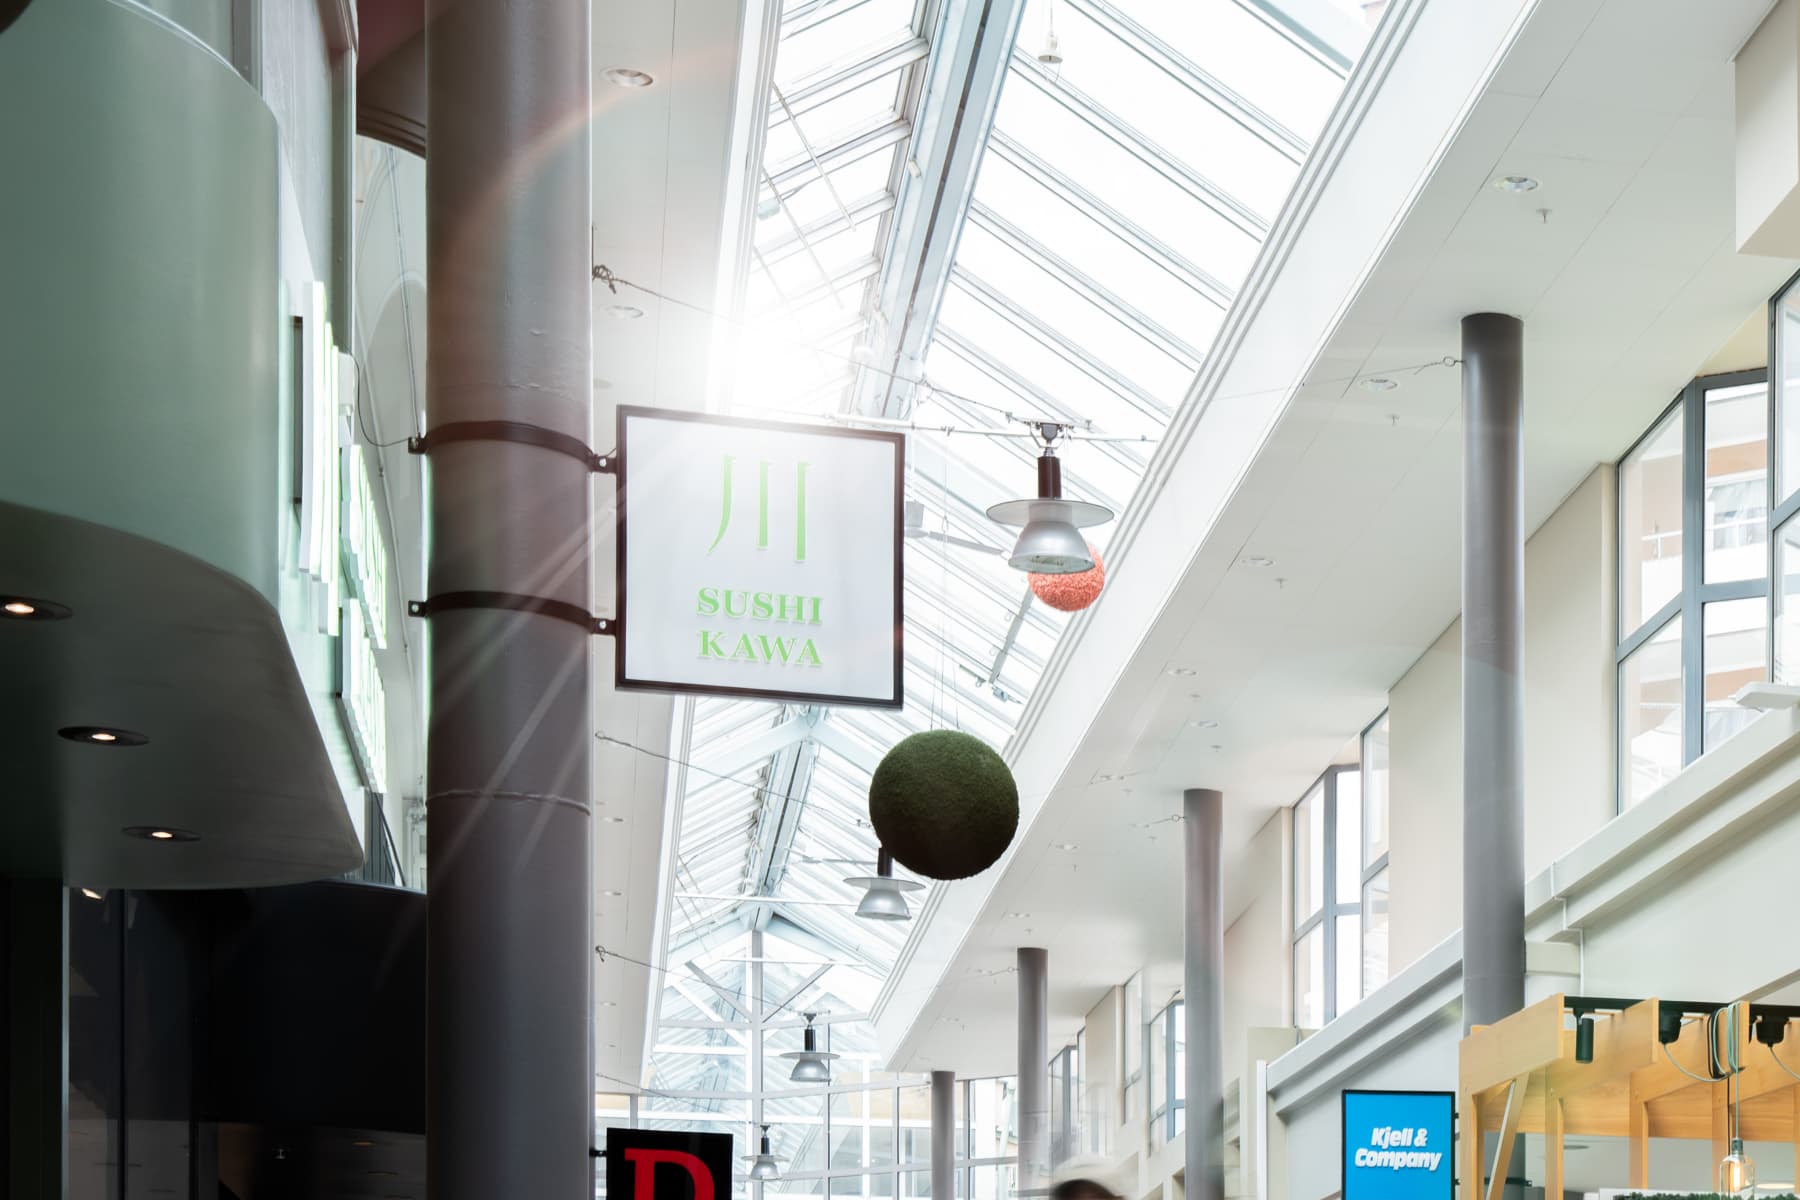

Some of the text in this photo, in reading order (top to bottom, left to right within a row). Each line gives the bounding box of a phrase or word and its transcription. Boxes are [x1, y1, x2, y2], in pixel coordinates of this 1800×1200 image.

[695, 586, 825, 625] SUSHI
[697, 629, 824, 667] KAWA
[1370, 1126, 1428, 1149] Kjell &
[1354, 1147, 1443, 1172] Company
